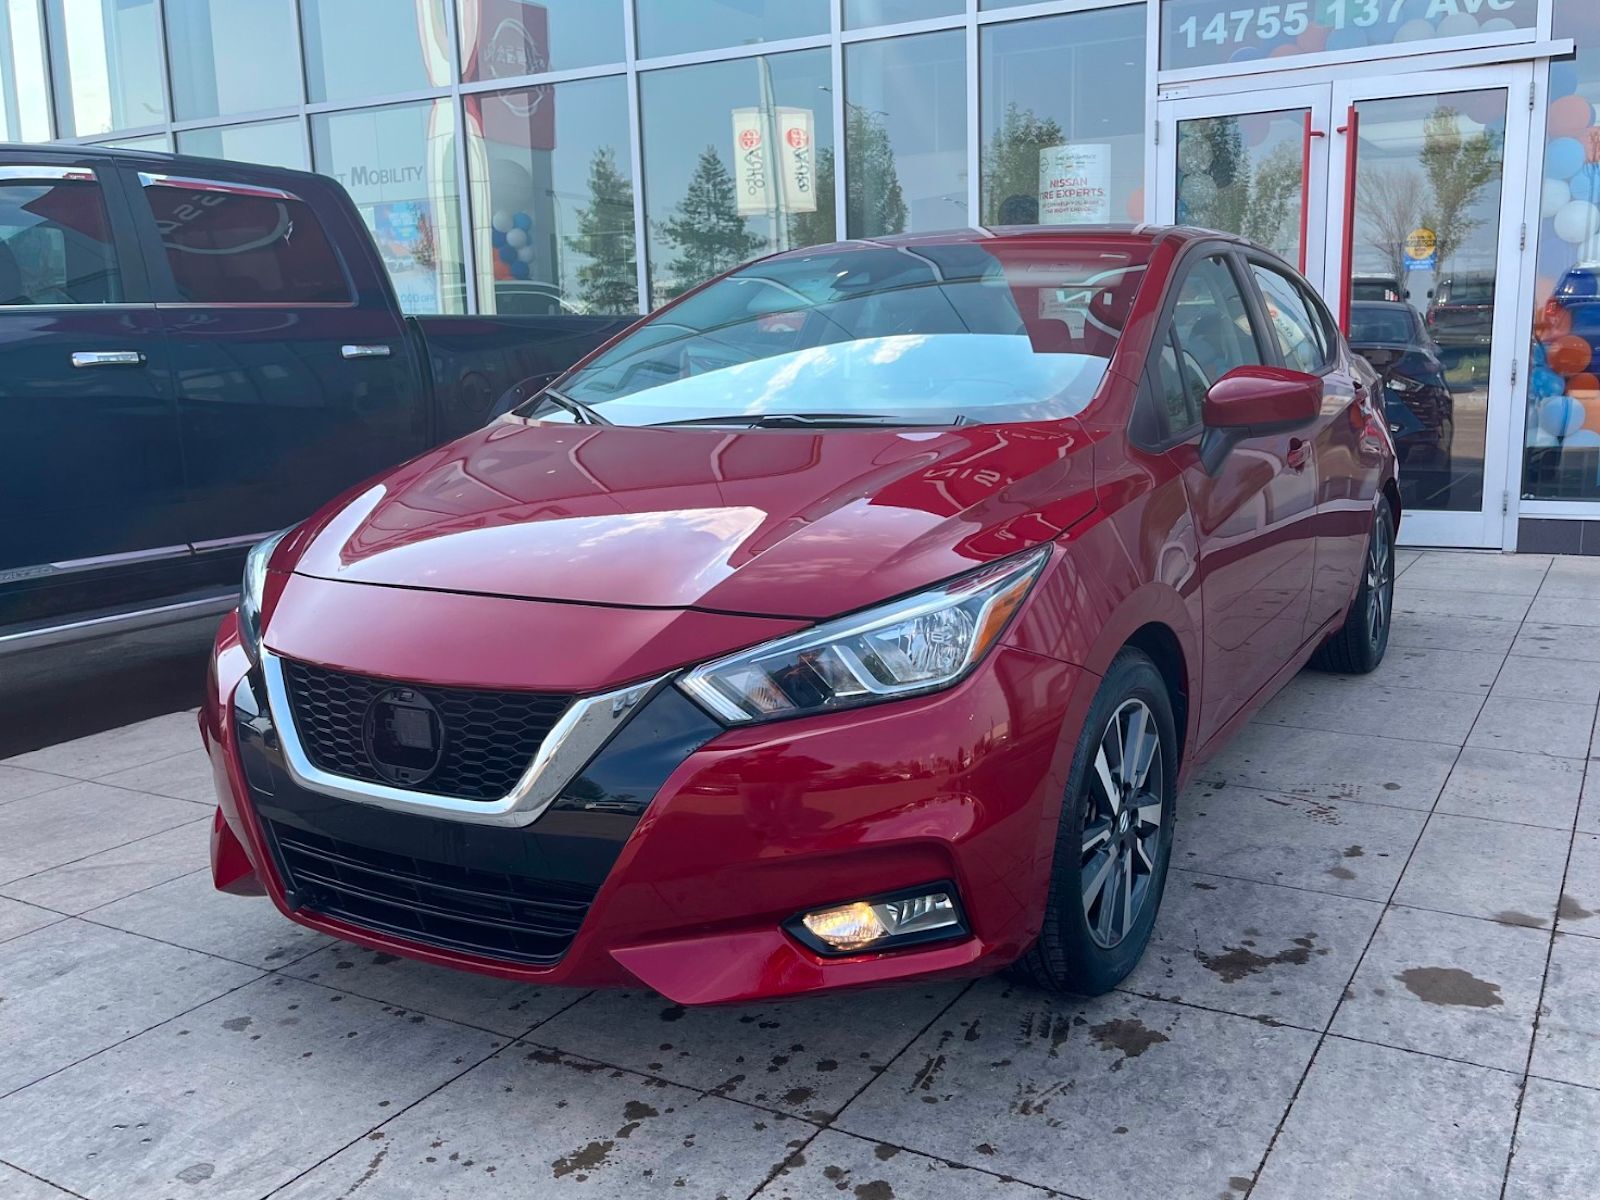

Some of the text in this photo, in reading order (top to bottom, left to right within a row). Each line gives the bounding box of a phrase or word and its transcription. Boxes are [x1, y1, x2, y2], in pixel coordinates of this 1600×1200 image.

[1178, 1, 1309, 48] 14755
[1326, 0, 1405, 30] 137
[351, 165, 423, 187] MOBILITY
[1050, 178, 1087, 188] NISSAN
